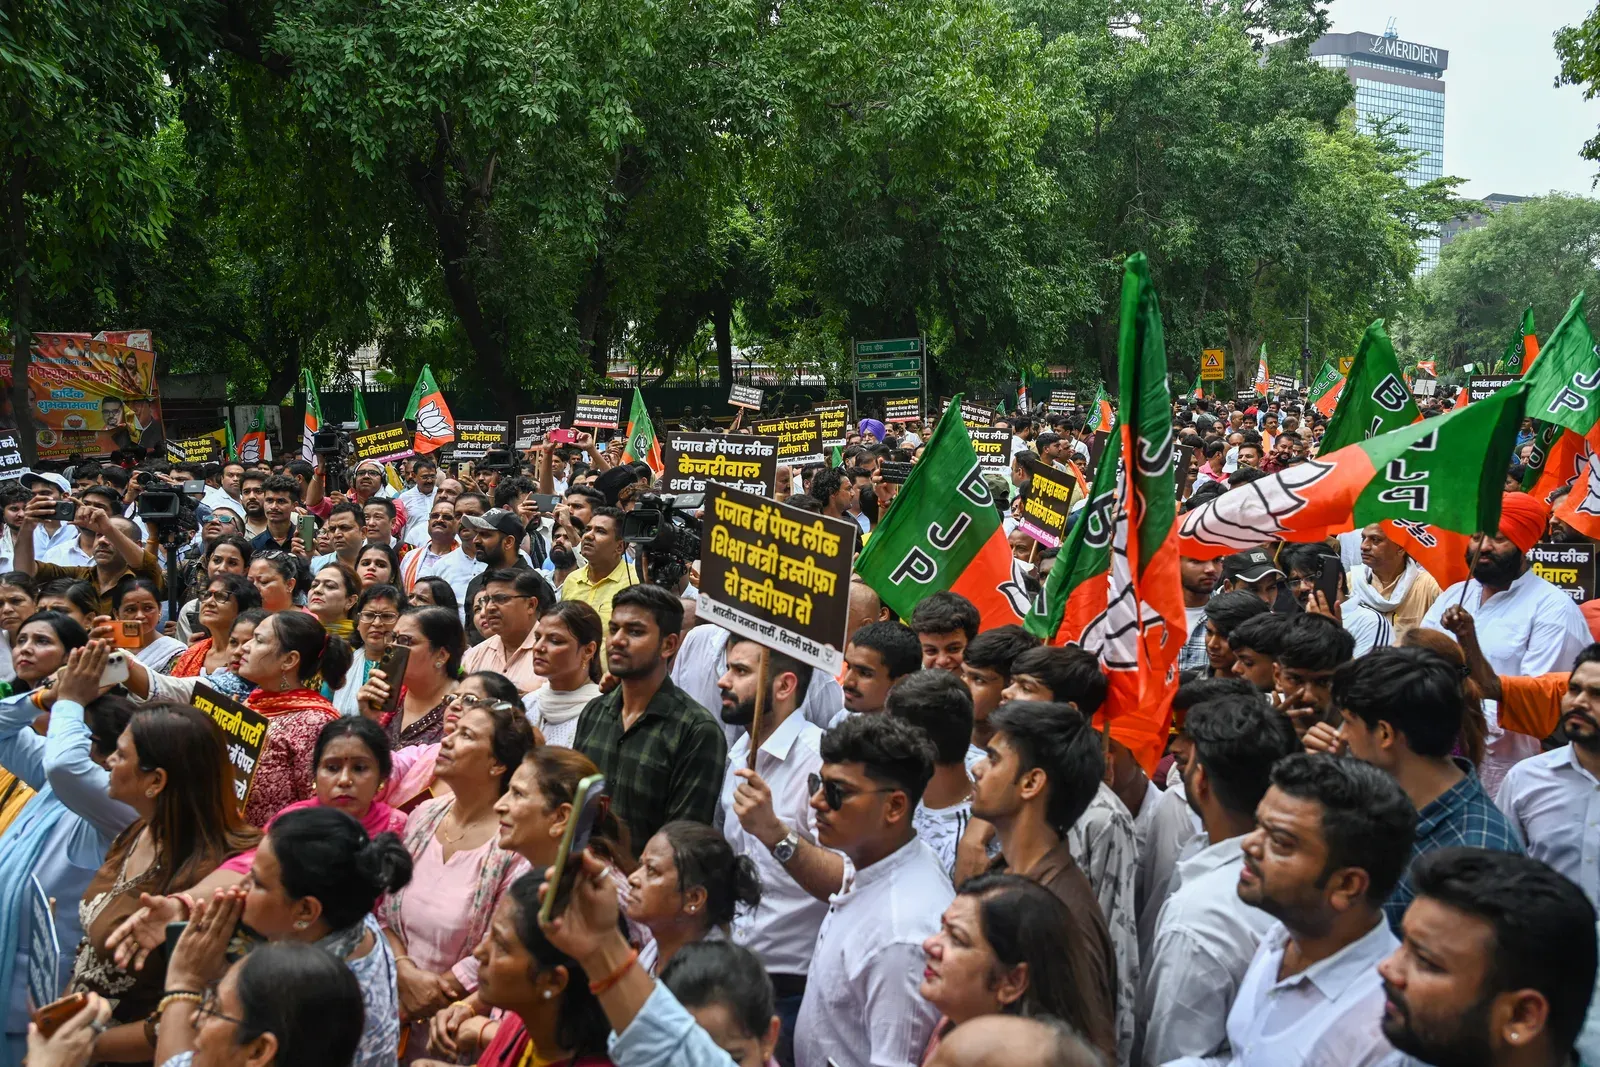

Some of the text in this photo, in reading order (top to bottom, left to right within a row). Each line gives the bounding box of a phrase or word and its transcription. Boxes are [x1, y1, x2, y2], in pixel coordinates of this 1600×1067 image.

[1369, 36, 1438, 65] Le MERIDIEN
[1472, 379, 1490, 387] भगवंत
[50, 386, 84, 400] हार्दिक
[1472, 390, 1485, 400] पेपर
[590, 398, 606, 406] आदमी
[834, 410, 845, 418] लीक
[977, 408, 991, 416] पंजाब
[536, 417, 540, 425] के
[758, 423, 776, 433] पंजाब
[785, 420, 799, 430] पेपर
[799, 418, 816, 428] लीक
[979, 416, 990, 424] खेल
[199, 438, 210, 446] लीक
[356, 428, 403, 447] युवा पूछ रहा सवाल
[461, 431, 501, 441] केजरीवाल
[792, 430, 817, 442] इस्तीफ़ा
[974, 430, 990, 439] पेपर
[991, 431, 1009, 440] लीक
[368, 444, 389, 455] मिलेगा
[672, 436, 774, 456] पंजाब में पेपर लीक
[802, 442, 809, 452] दो
[4, 450, 22, 464] करो
[990, 454, 1005, 463] करो
[678, 453, 761, 478] केजरीवाल
[670, 476, 695, 491] शर्म
[1039, 476, 1048, 497] पूछ
[1053, 482, 1069, 502] सवाल
[714, 491, 841, 558] पंजाब में पेपर लीक
[710, 524, 838, 597] शिक्षा मंत्री इस्तीफ़ा
[1535, 548, 1559, 562] पेपर
[1560, 548, 1589, 563] लीक
[724, 567, 813, 625] दो इस्तीफ़ा दो
[712, 604, 737, 624] भारतीय
[738, 615, 758, 631] जनता
[779, 631, 801, 649] दिल्ली
[802, 642, 819, 658] प्रदेश
[193, 695, 265, 748] आम आदमी पार्टी
[238, 747, 255, 774] पेपर
